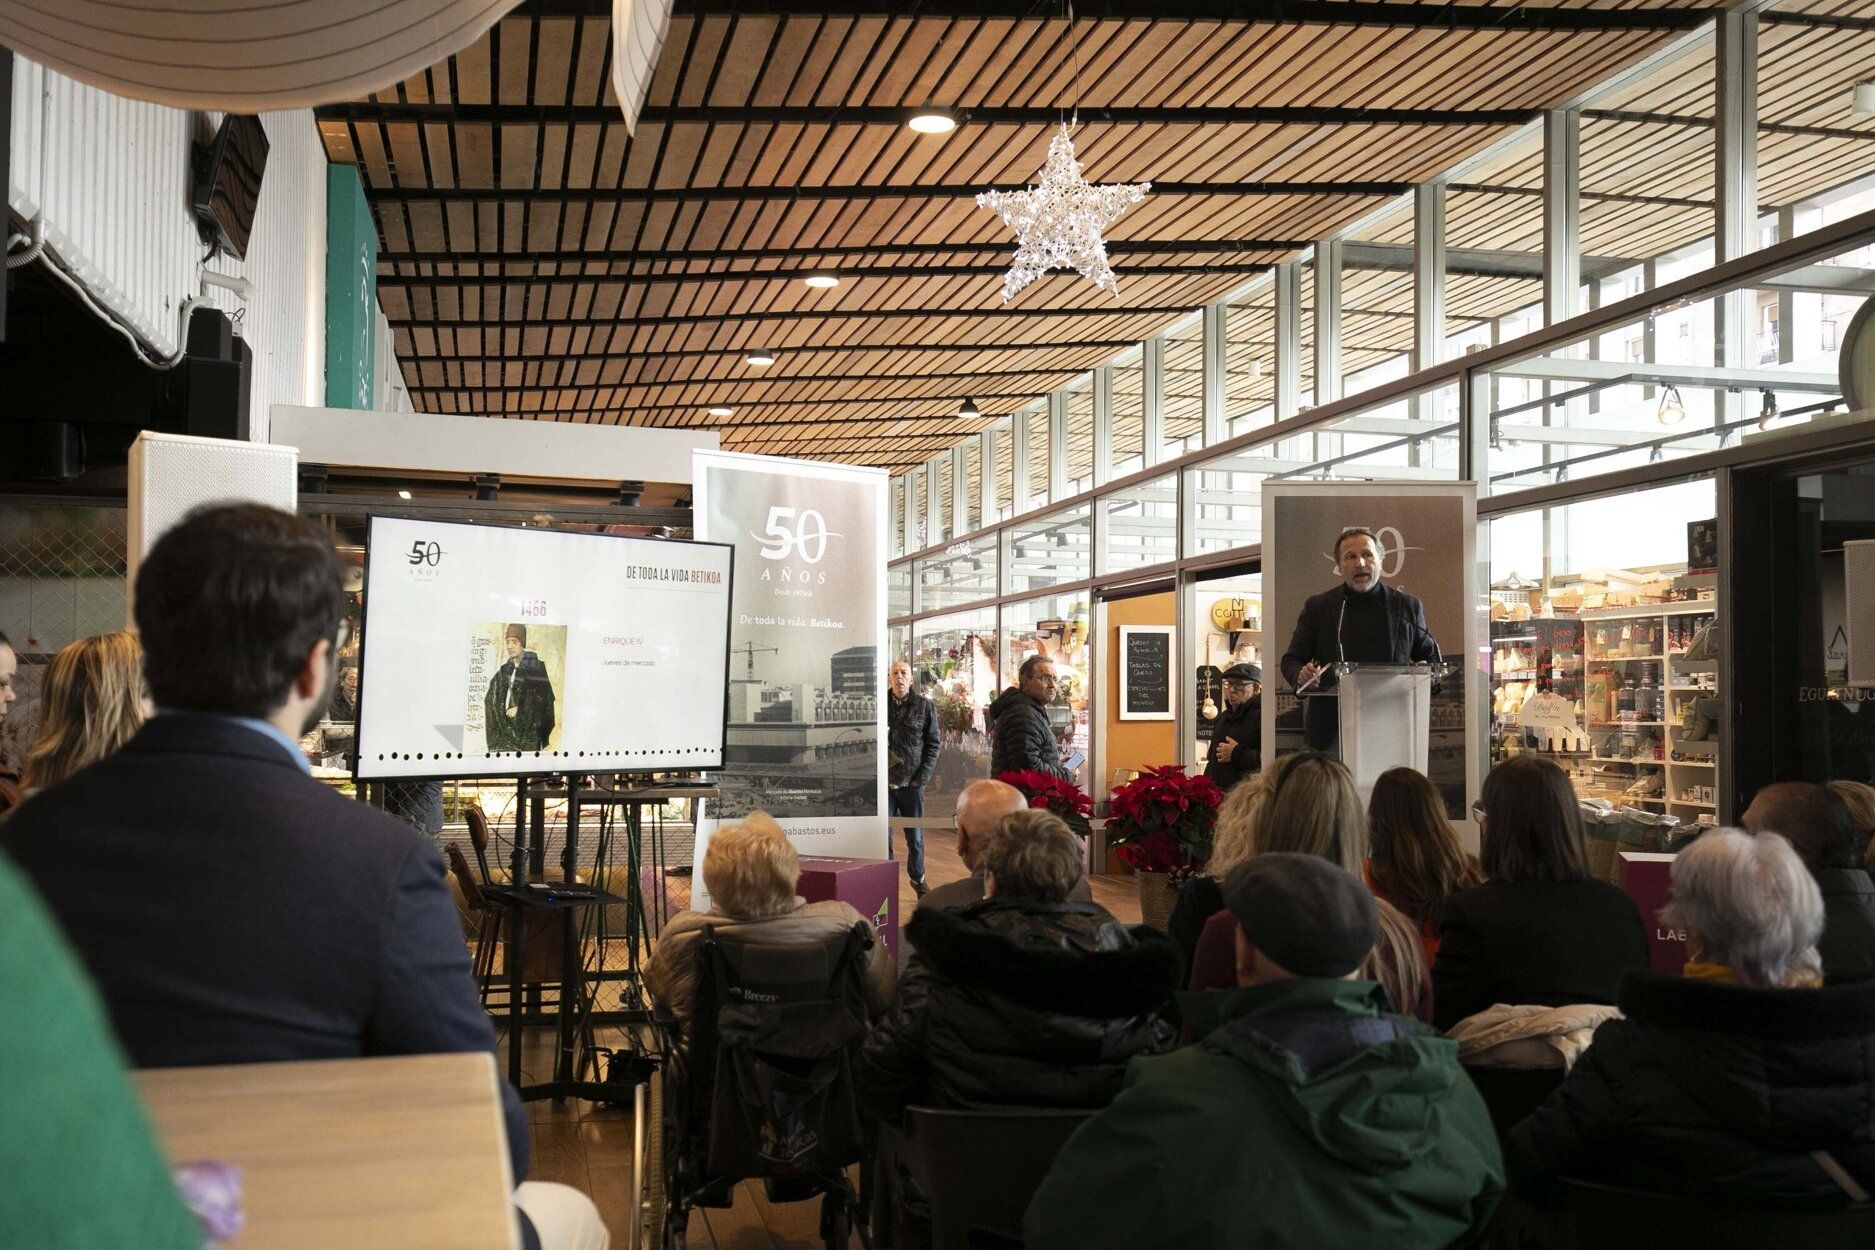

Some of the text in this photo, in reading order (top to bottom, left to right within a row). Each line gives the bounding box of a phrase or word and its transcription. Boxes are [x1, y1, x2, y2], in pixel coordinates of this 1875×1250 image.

[760, 506, 826, 563] 50
[409, 541, 440, 567] 50
[626, 565, 721, 584] DE TODA LA VIDA BETIKOA
[760, 567, 826, 584] AÑOS
[521, 600, 547, 617] 1466
[740, 614, 753, 624] De
[755, 616, 775, 625] toda
[778, 617, 786, 626] la
[603, 637, 635, 647] ENRIQUE
